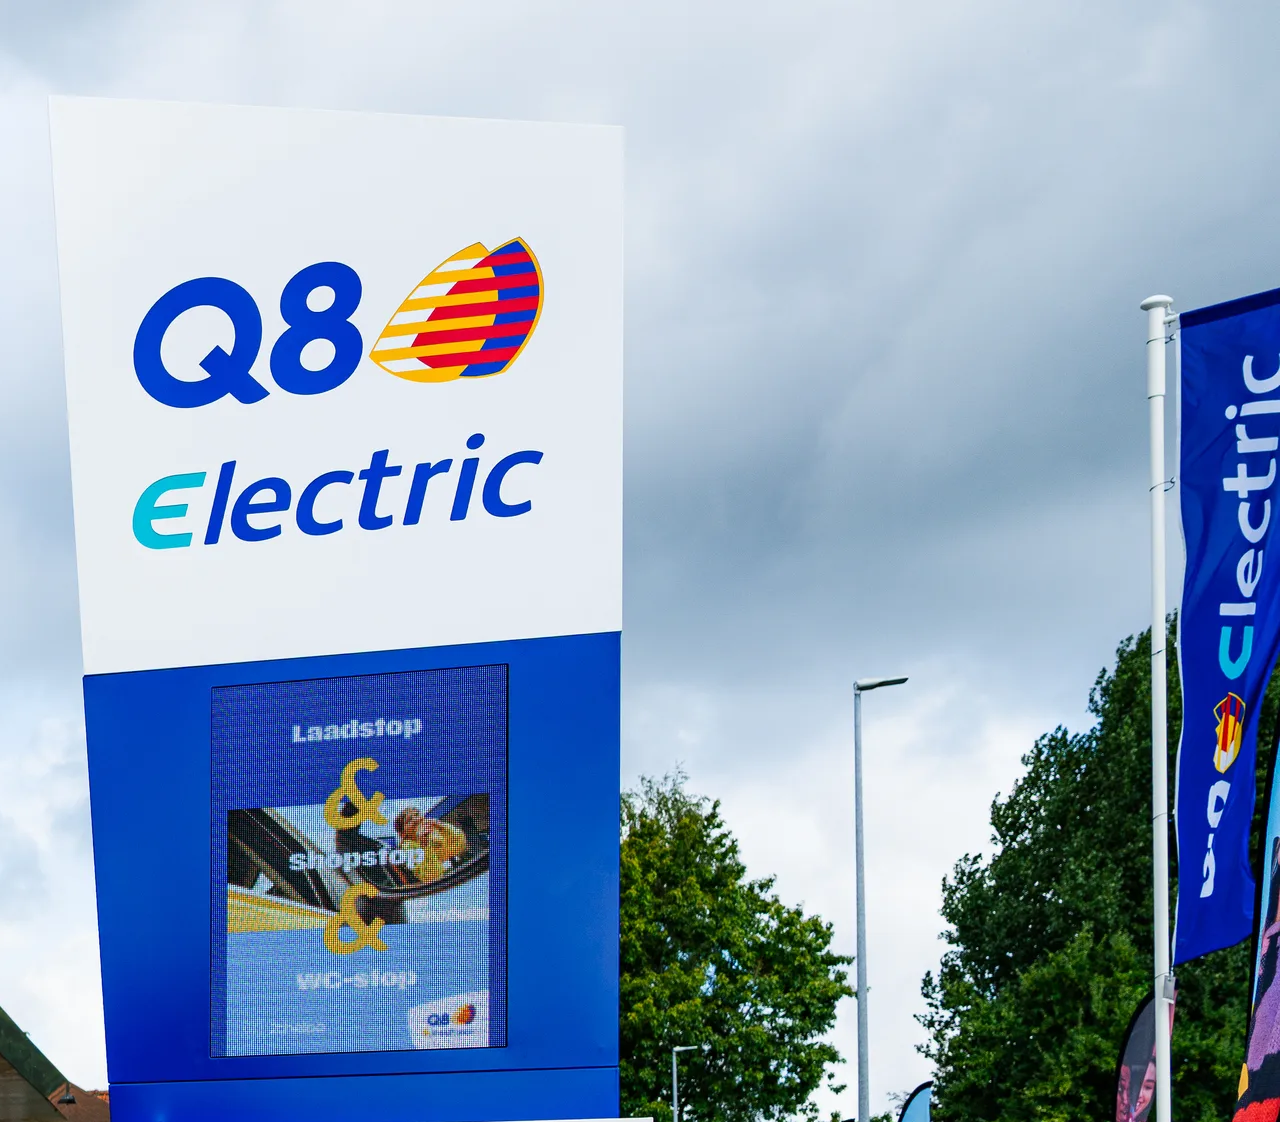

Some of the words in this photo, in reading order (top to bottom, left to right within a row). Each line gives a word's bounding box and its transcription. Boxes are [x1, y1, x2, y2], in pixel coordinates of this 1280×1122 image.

[133, 261, 363, 408] Q8
[132, 433, 544, 549] Electric
[293, 717, 422, 743] Laadstop
[324, 757, 388, 830] &
[323, 882, 389, 955] &
